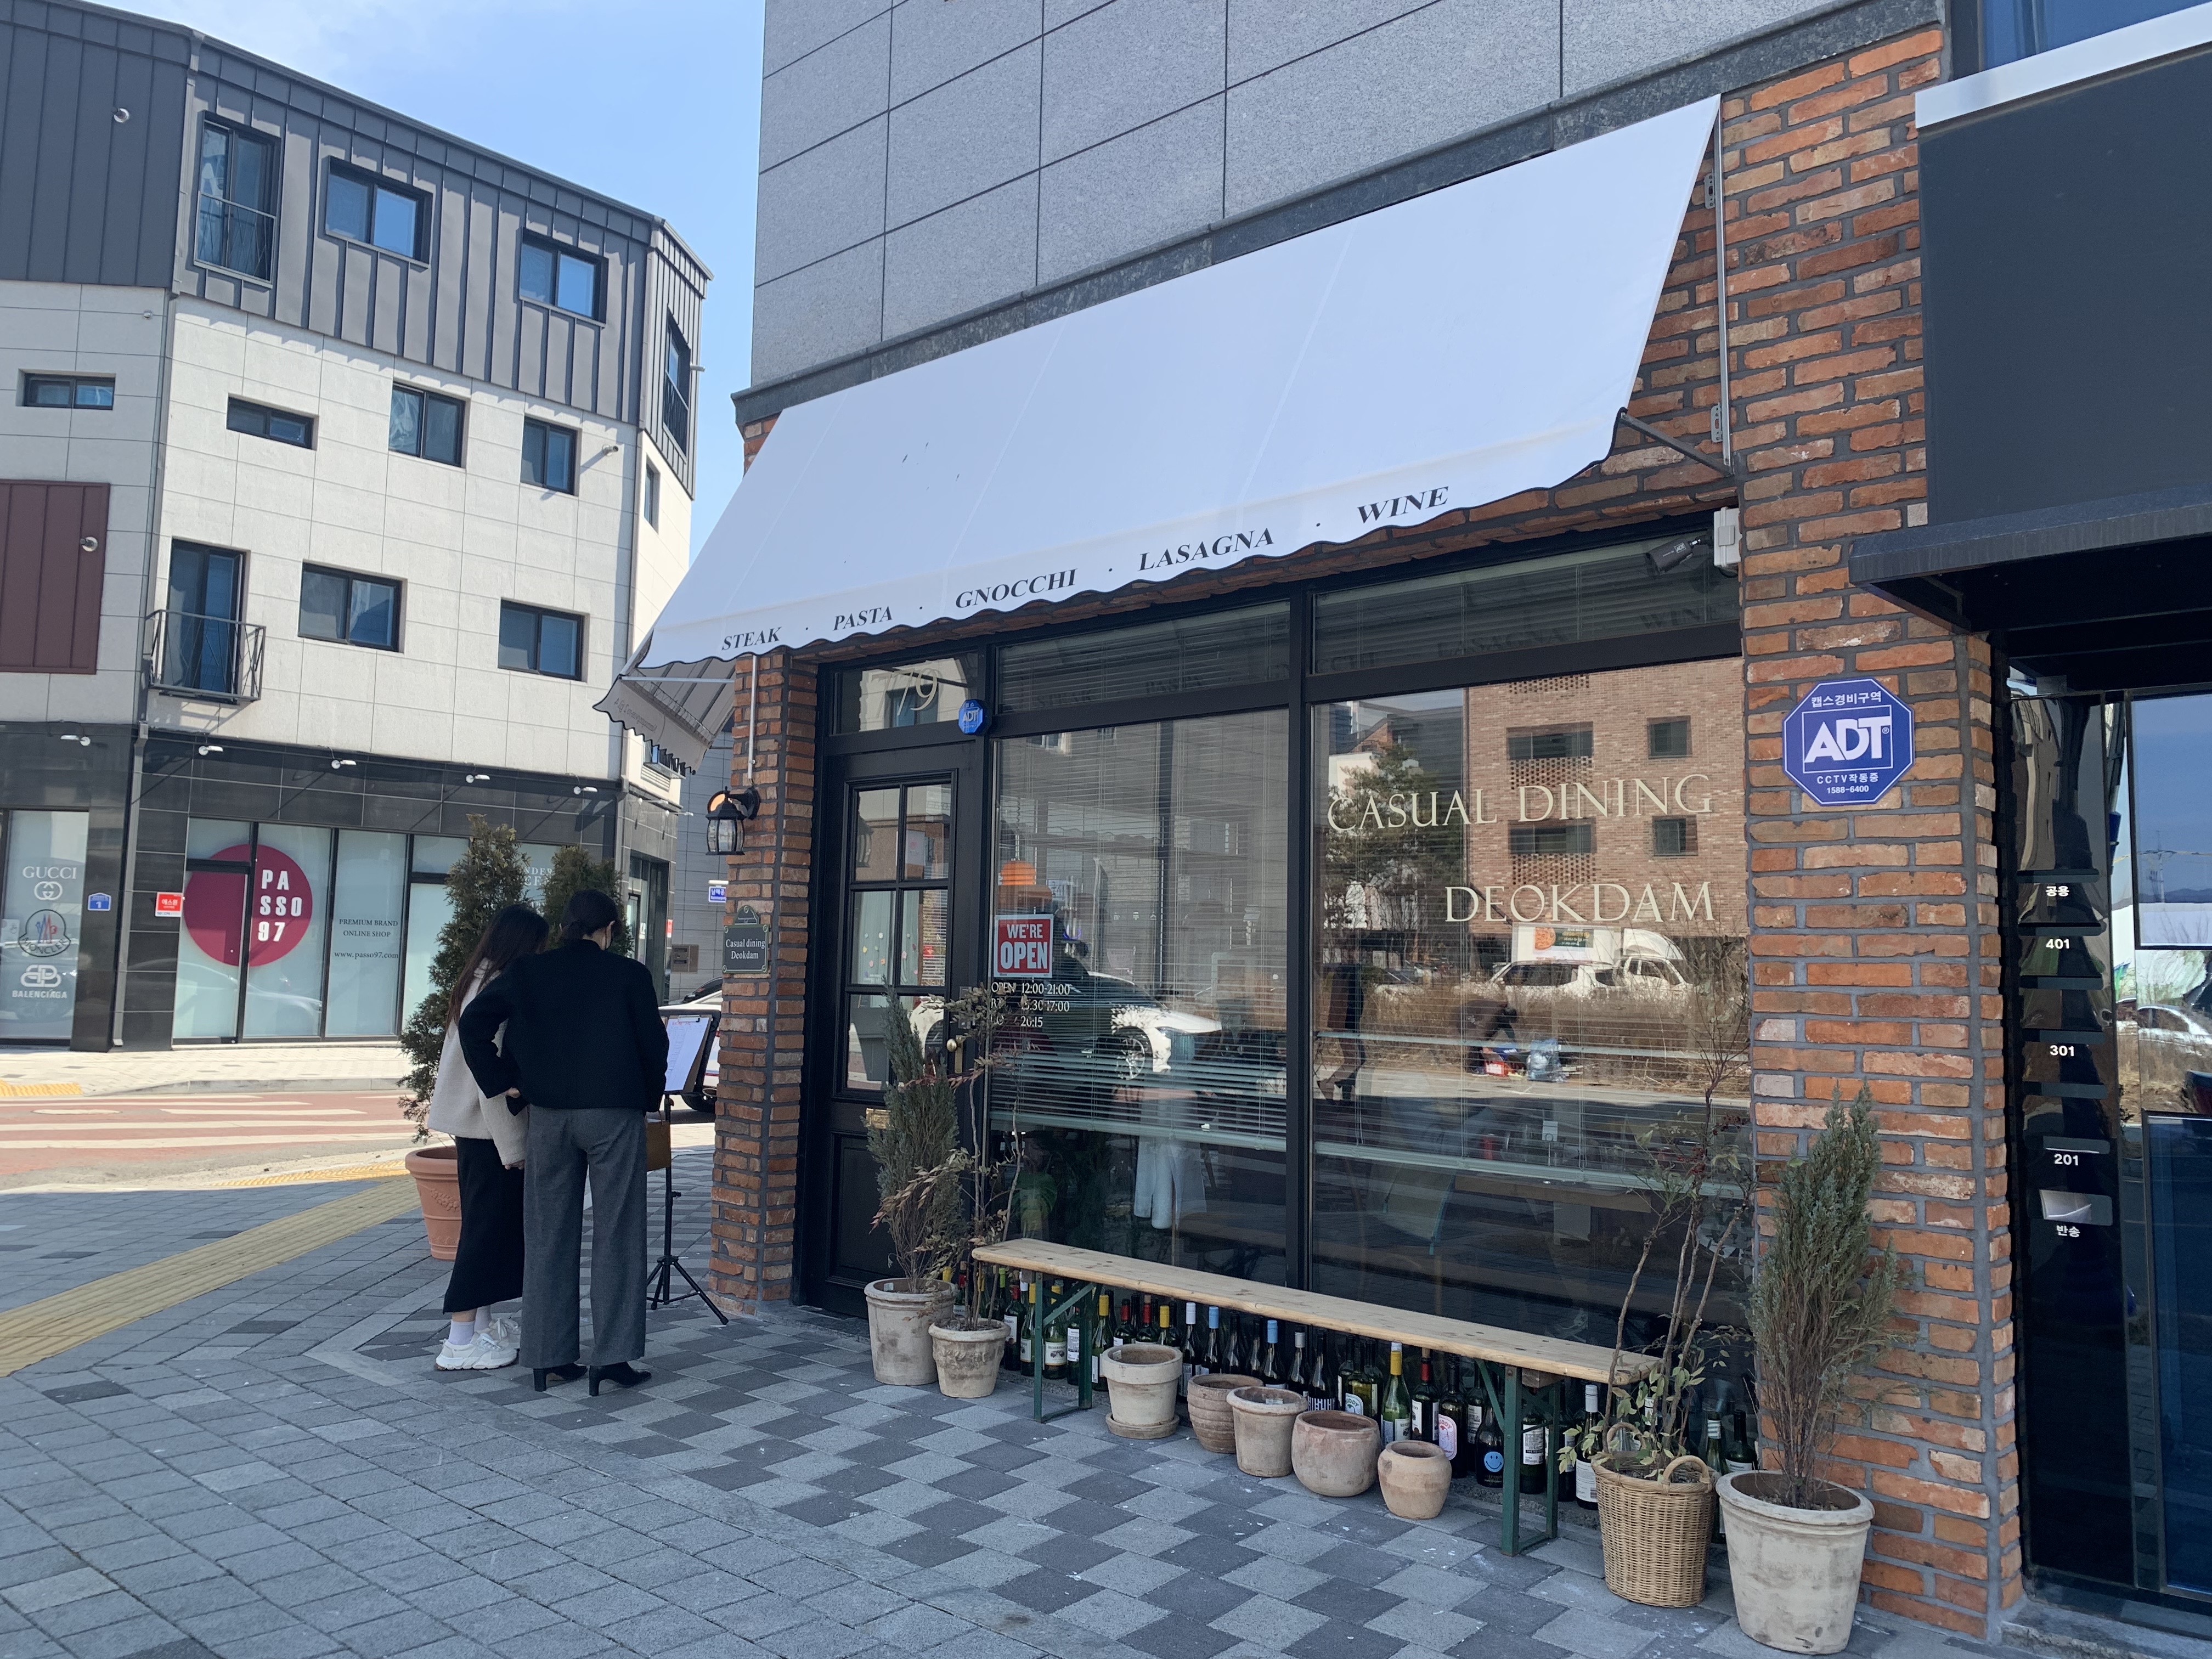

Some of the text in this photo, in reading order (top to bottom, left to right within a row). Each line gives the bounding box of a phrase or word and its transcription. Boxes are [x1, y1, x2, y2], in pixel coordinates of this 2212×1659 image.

[721, 486, 1449, 651] STEAK PASTA GNOCCHI LASAGNA WINE
[872, 668, 938, 717] 779
[1812, 691, 1882, 708] 캡스경비구역
[1804, 716, 1892, 763] ADT
[1817, 772, 1879, 784] CCTV작동중
[1827, 785, 1869, 794] 1588-6400
[1328, 774, 1712, 831] CASUAL DINING
[22, 866, 77, 879] GUCCI
[261, 869, 289, 890] PA
[2046, 885, 2069, 896] 공용
[259, 895, 302, 917] SSO
[1445, 882, 1715, 922] DEOKDAM
[258, 921, 285, 942] 97
[1007, 924, 1043, 939] WE'RE
[21, 937, 68, 955] MONCLER
[726, 939, 765, 949] Casual dining
[2046, 939, 2070, 949] 401
[731, 950, 759, 960] Deokdam
[1000, 941, 1048, 969] OPEN
[12, 990, 67, 999] BALENCIAGA
[991, 982, 1070, 995] OPEN 12:00-21:00
[1020, 1015, 1043, 1028] 20:15
[2050, 1045, 2074, 1057] 301
[2054, 1153, 2079, 1166] 201
[2057, 1224, 2080, 1238] 반송
